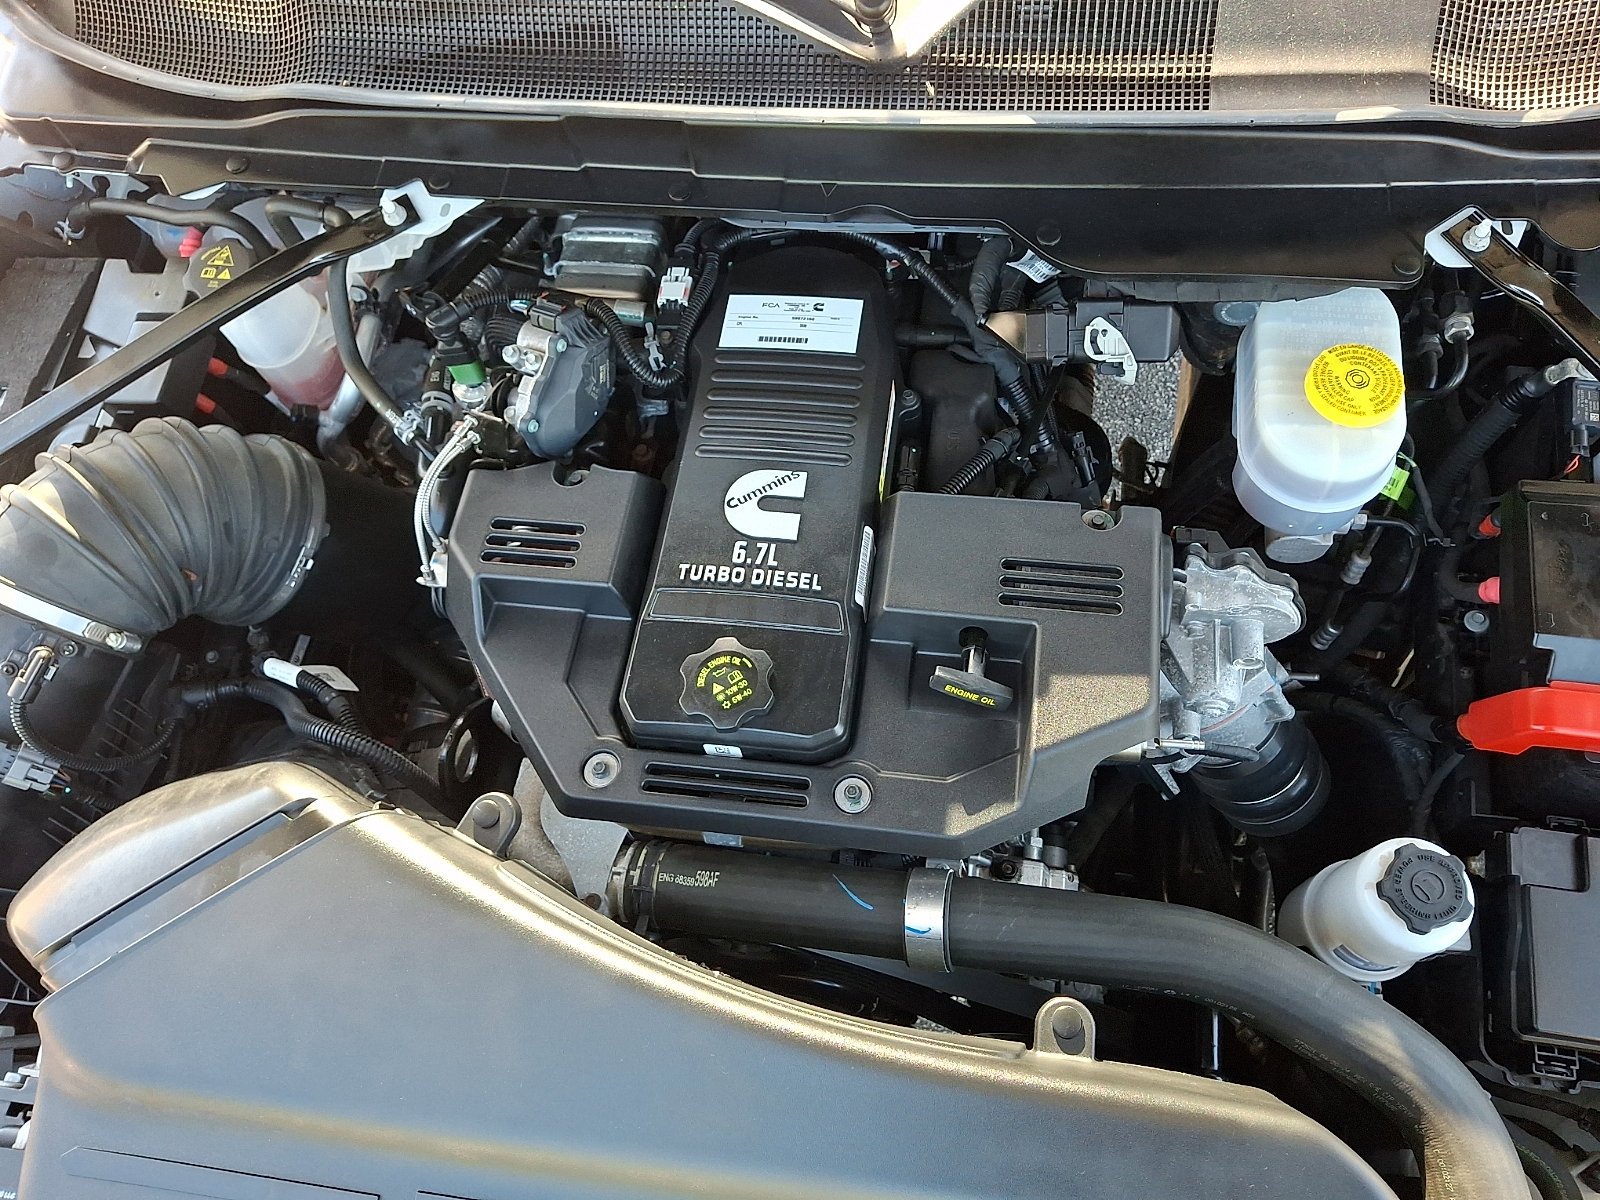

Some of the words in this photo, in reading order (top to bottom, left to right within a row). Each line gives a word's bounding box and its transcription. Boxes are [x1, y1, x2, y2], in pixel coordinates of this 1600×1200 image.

[727, 470, 801, 509] Cummins
[732, 540, 778, 566] 6.7L
[679, 563, 746, 584] TURBO
[750, 568, 822, 591] DIESEL
[696, 666, 710, 687] DIESEL
[707, 655, 731, 668] ENGINE
[731, 656, 741, 666] OIL
[944, 684, 979, 701] ENGINE
[980, 696, 996, 706] OIL
[658, 872, 675, 882] ENG
